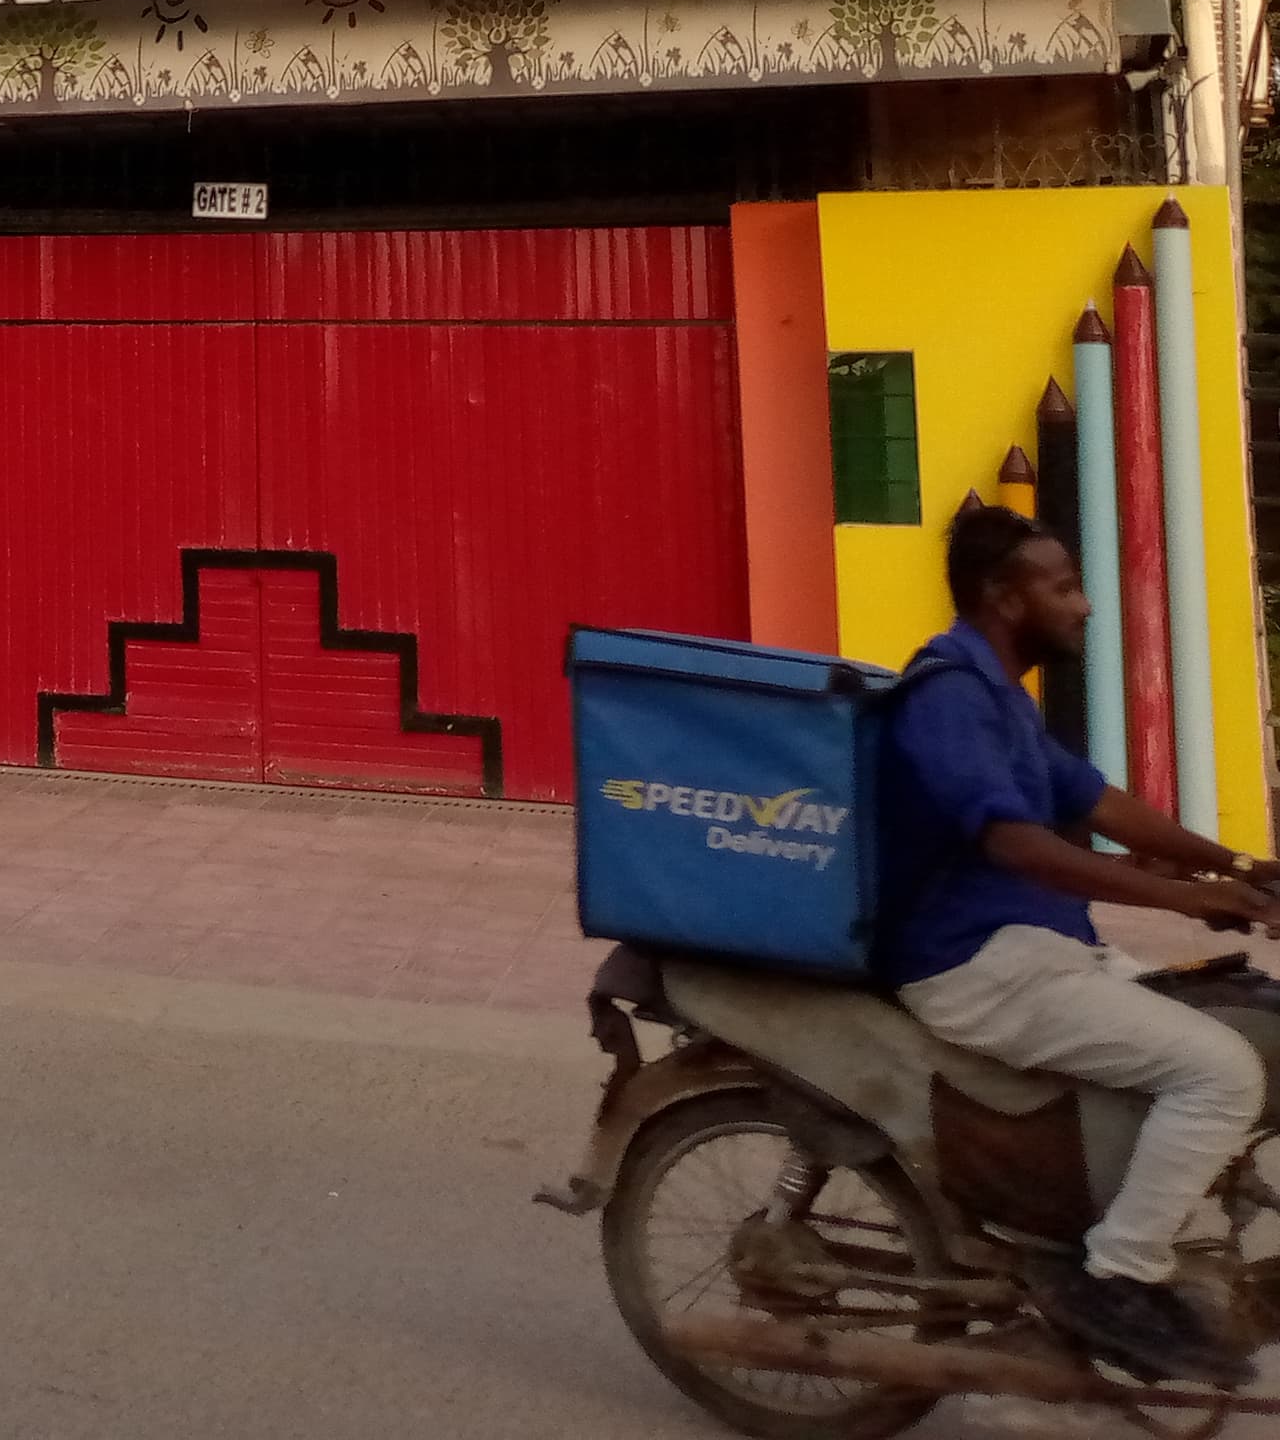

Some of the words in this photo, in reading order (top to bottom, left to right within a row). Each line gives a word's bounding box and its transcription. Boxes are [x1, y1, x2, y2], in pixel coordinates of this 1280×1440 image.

[197, 185, 237, 213] GATE
[241, 187, 251, 214] #
[255, 188, 265, 214] 2
[599, 778, 848, 835] SPEEDWAY
[705, 825, 837, 871] Delivery
